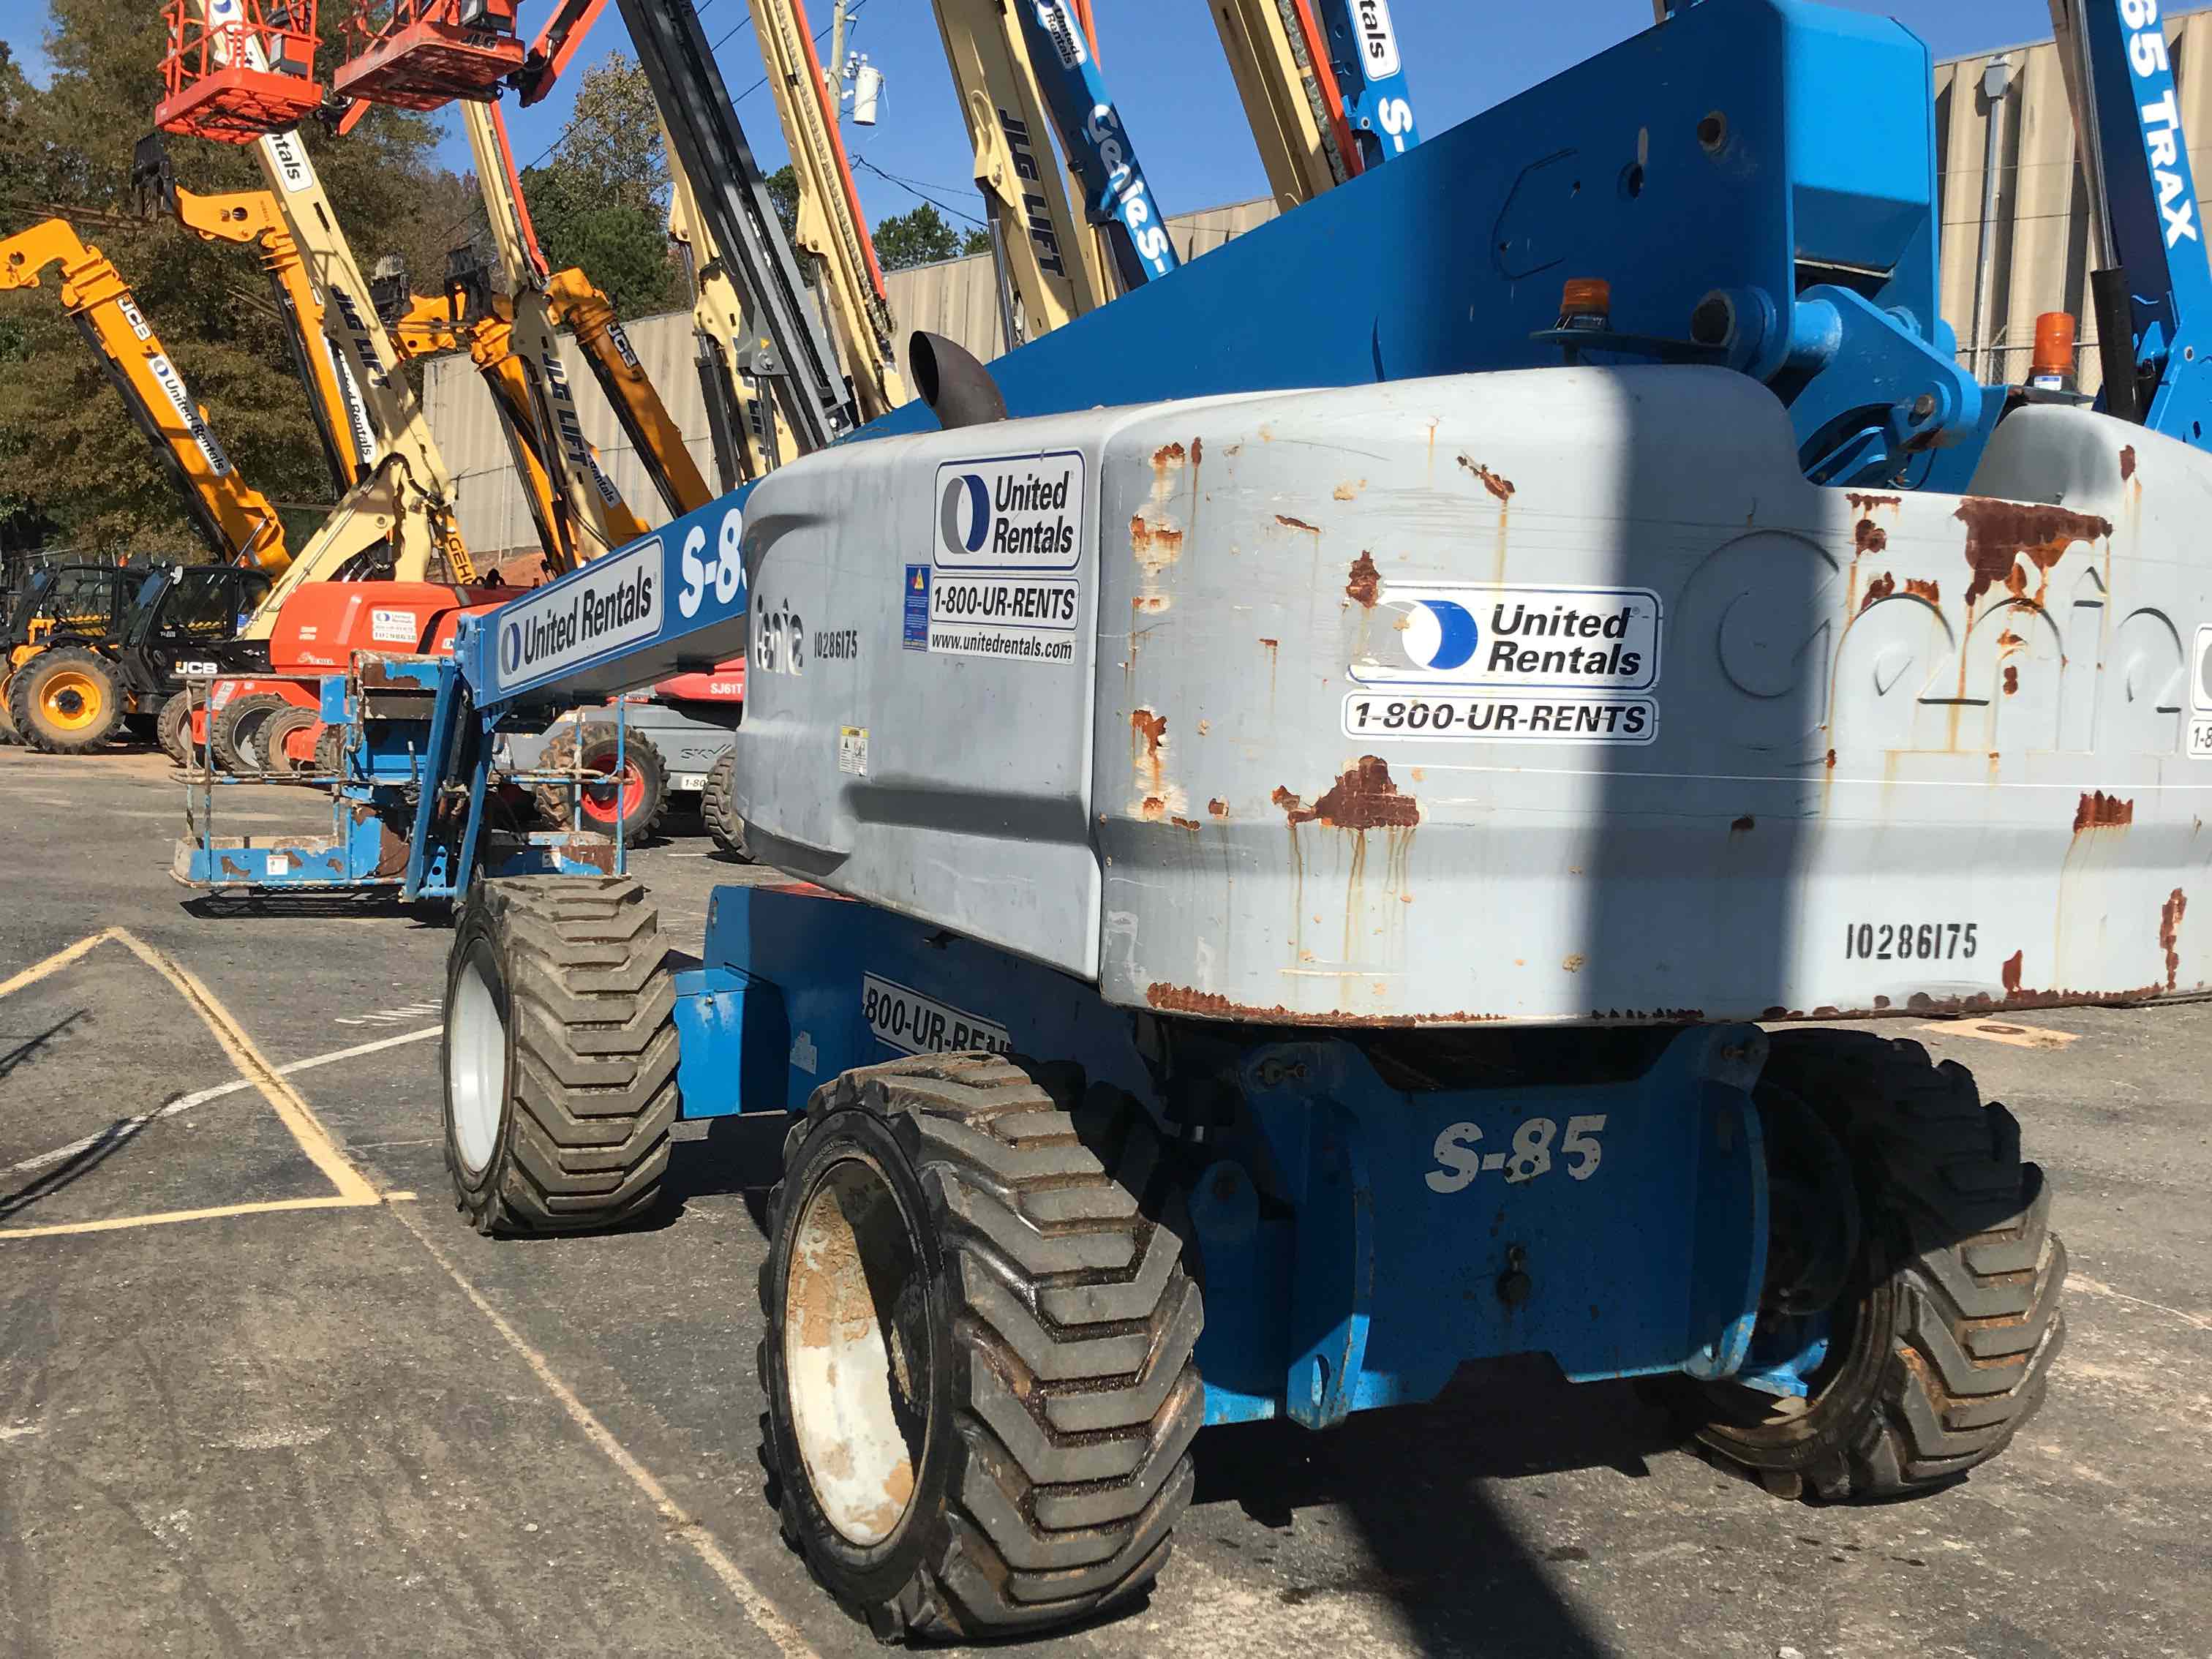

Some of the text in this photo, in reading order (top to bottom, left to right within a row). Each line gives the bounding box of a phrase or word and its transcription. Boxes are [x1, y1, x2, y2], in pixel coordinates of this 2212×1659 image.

[1045, 13, 1072, 64] Rentals
[1053, 5, 1080, 54] United
[1088, 105, 1148, 229] Genie
[2142, 89, 2197, 249] TRAX
[998, 109, 1066, 277] JLG LIFT
[117, 295, 152, 342] JCB
[331, 285, 366, 331] JLG
[606, 321, 637, 369] JCB
[165, 380, 224, 470] United Rentals
[351, 405, 372, 456] Rentals
[542, 351, 589, 467] JLG LIFT
[995, 470, 1069, 512] United
[993, 516, 1074, 554] Rentals
[679, 508, 748, 618] S-8
[524, 565, 652, 666] United Rentals
[934, 586, 1075, 620] 1-800-UR-RENTS
[1491, 603, 1632, 639] United
[814, 631, 857, 659] 10286175
[932, 632, 1072, 660] www.unitedrentals.com
[1487, 641, 1641, 676] Rentals
[1671, 526, 2185, 754] Genie
[176, 661, 218, 674] JCB
[1355, 702, 1647, 734] 1-800-UR-RENTS
[1846, 923, 1979, 960] 10286175
[1424, 1114, 1607, 1194] S-85
